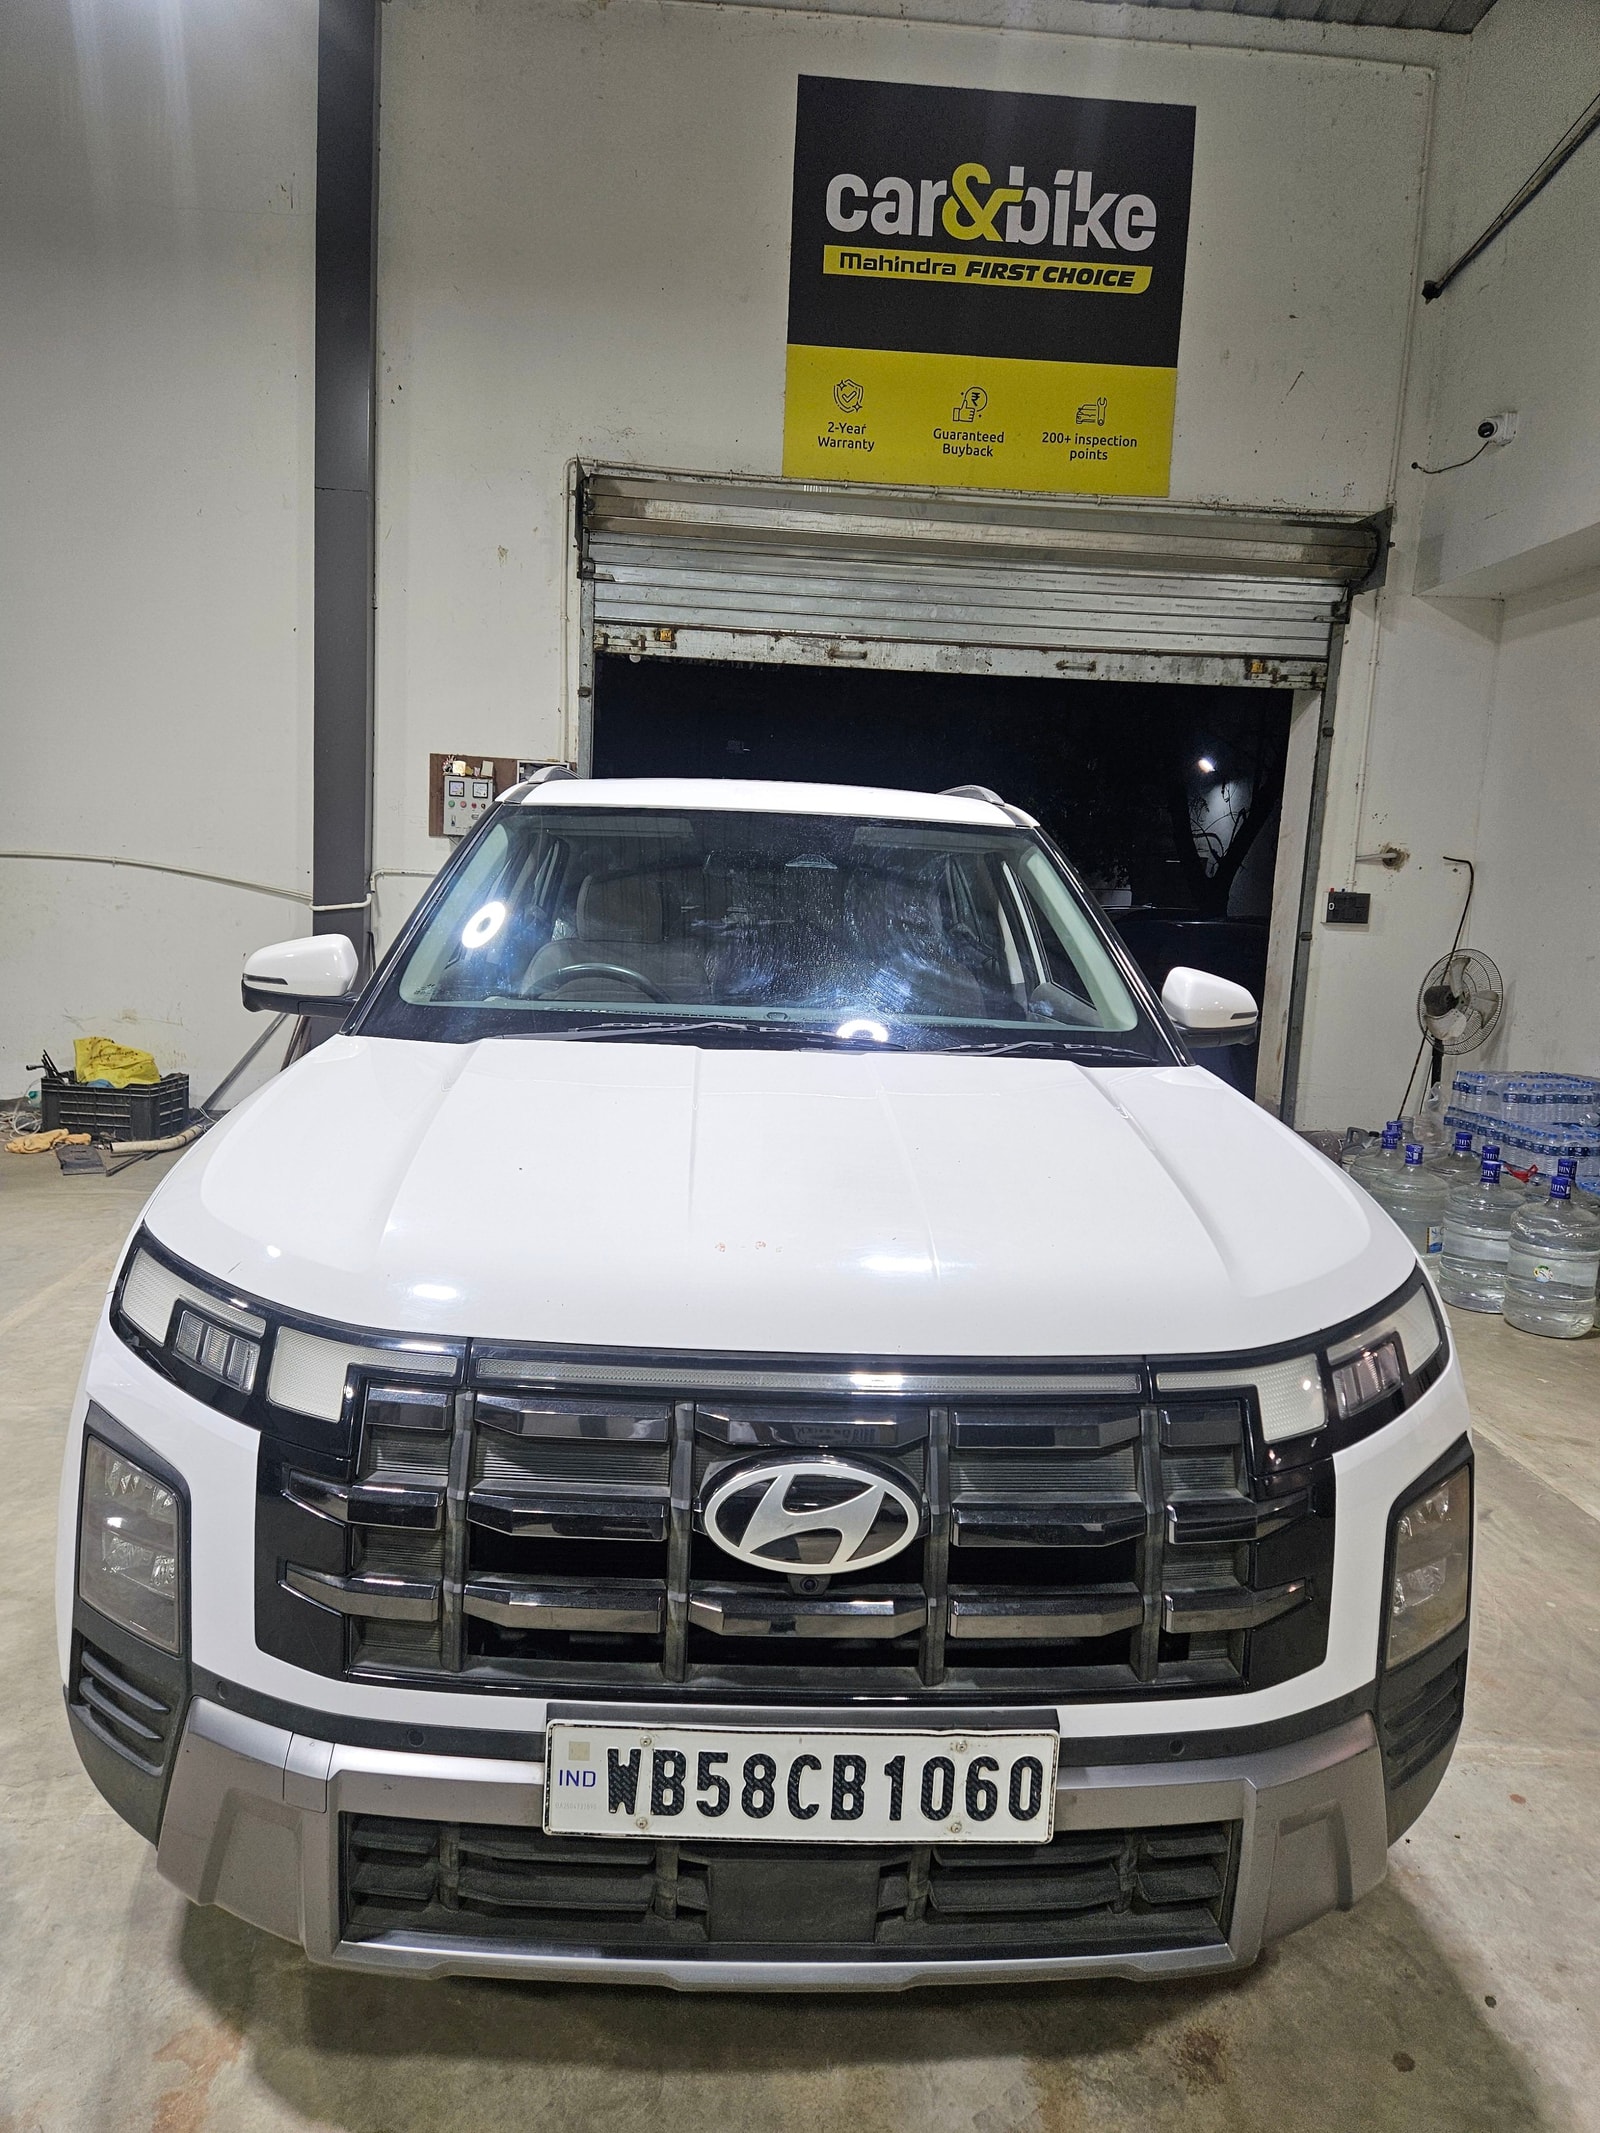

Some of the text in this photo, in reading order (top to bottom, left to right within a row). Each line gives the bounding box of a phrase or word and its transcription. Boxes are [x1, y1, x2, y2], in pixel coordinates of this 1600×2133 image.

[825, 162, 1157, 251] car&bike
[839, 252, 1136, 288] Mahindra FIRST CHOICE
[827, 421, 867, 435] 2-Year
[933, 428, 1005, 444] Guaranteed
[817, 436, 875, 453] Warranty
[1041, 432, 1138, 449] 200+ inspection
[942, 443, 994, 458] Buyback
[1069, 447, 1108, 461] points
[558, 1768, 597, 1788] IND
[607, 1748, 1044, 1822] WB58CB1060
